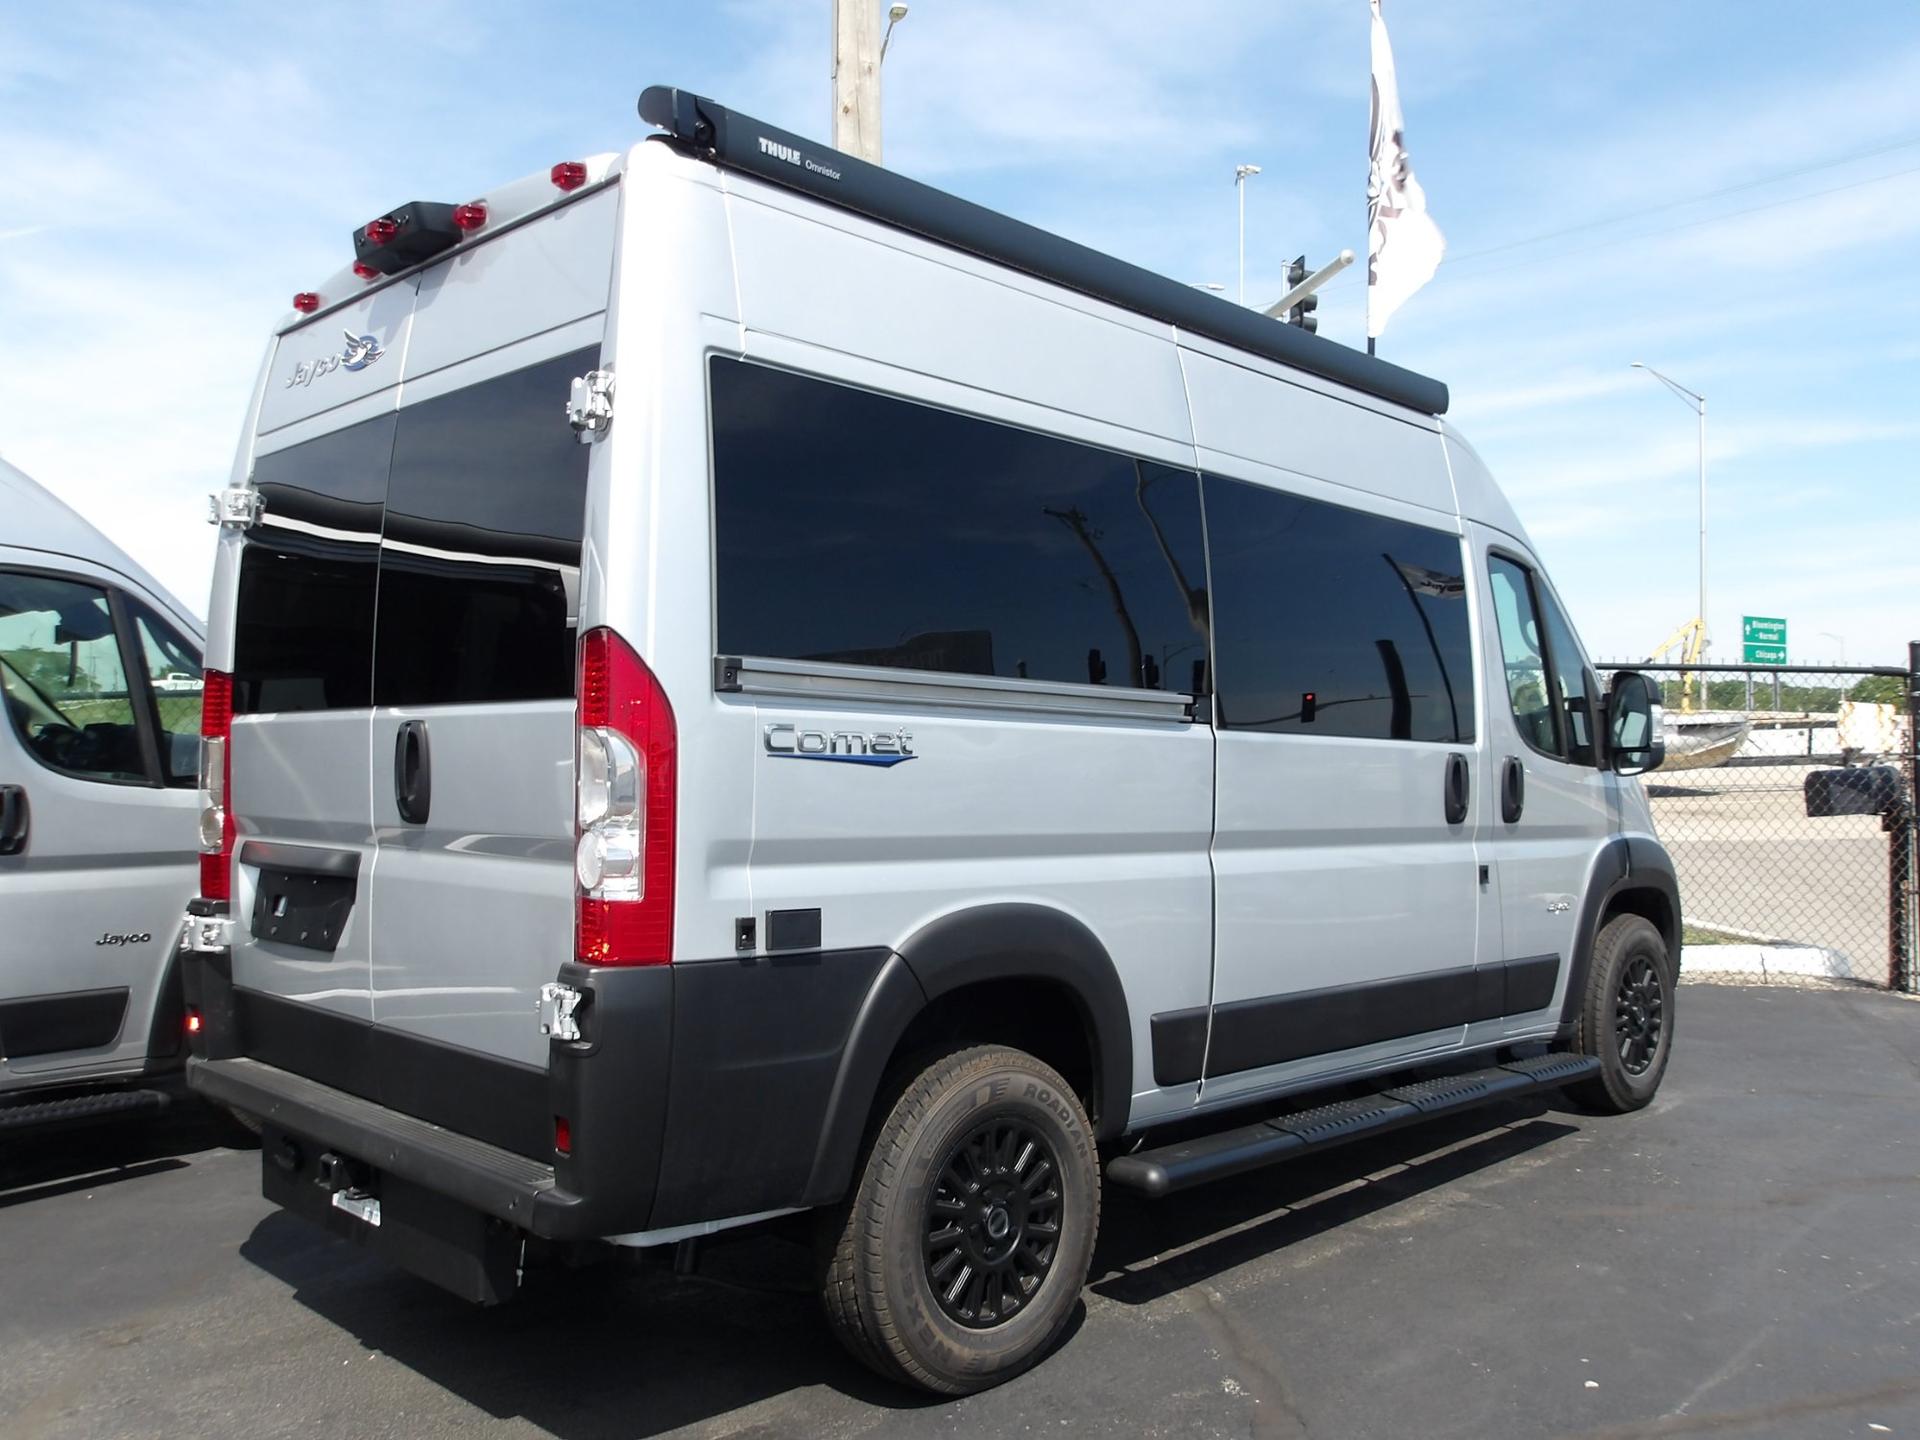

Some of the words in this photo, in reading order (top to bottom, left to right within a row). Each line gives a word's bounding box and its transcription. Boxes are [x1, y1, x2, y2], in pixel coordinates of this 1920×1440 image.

[758, 136, 800, 165] THULE
[805, 159, 841, 180] Omnistor
[285, 352, 341, 389] Jayco
[763, 723, 913, 755] Comet
[95, 933, 151, 946] Jayco
[1023, 1083, 1088, 1159] ROADIAN
